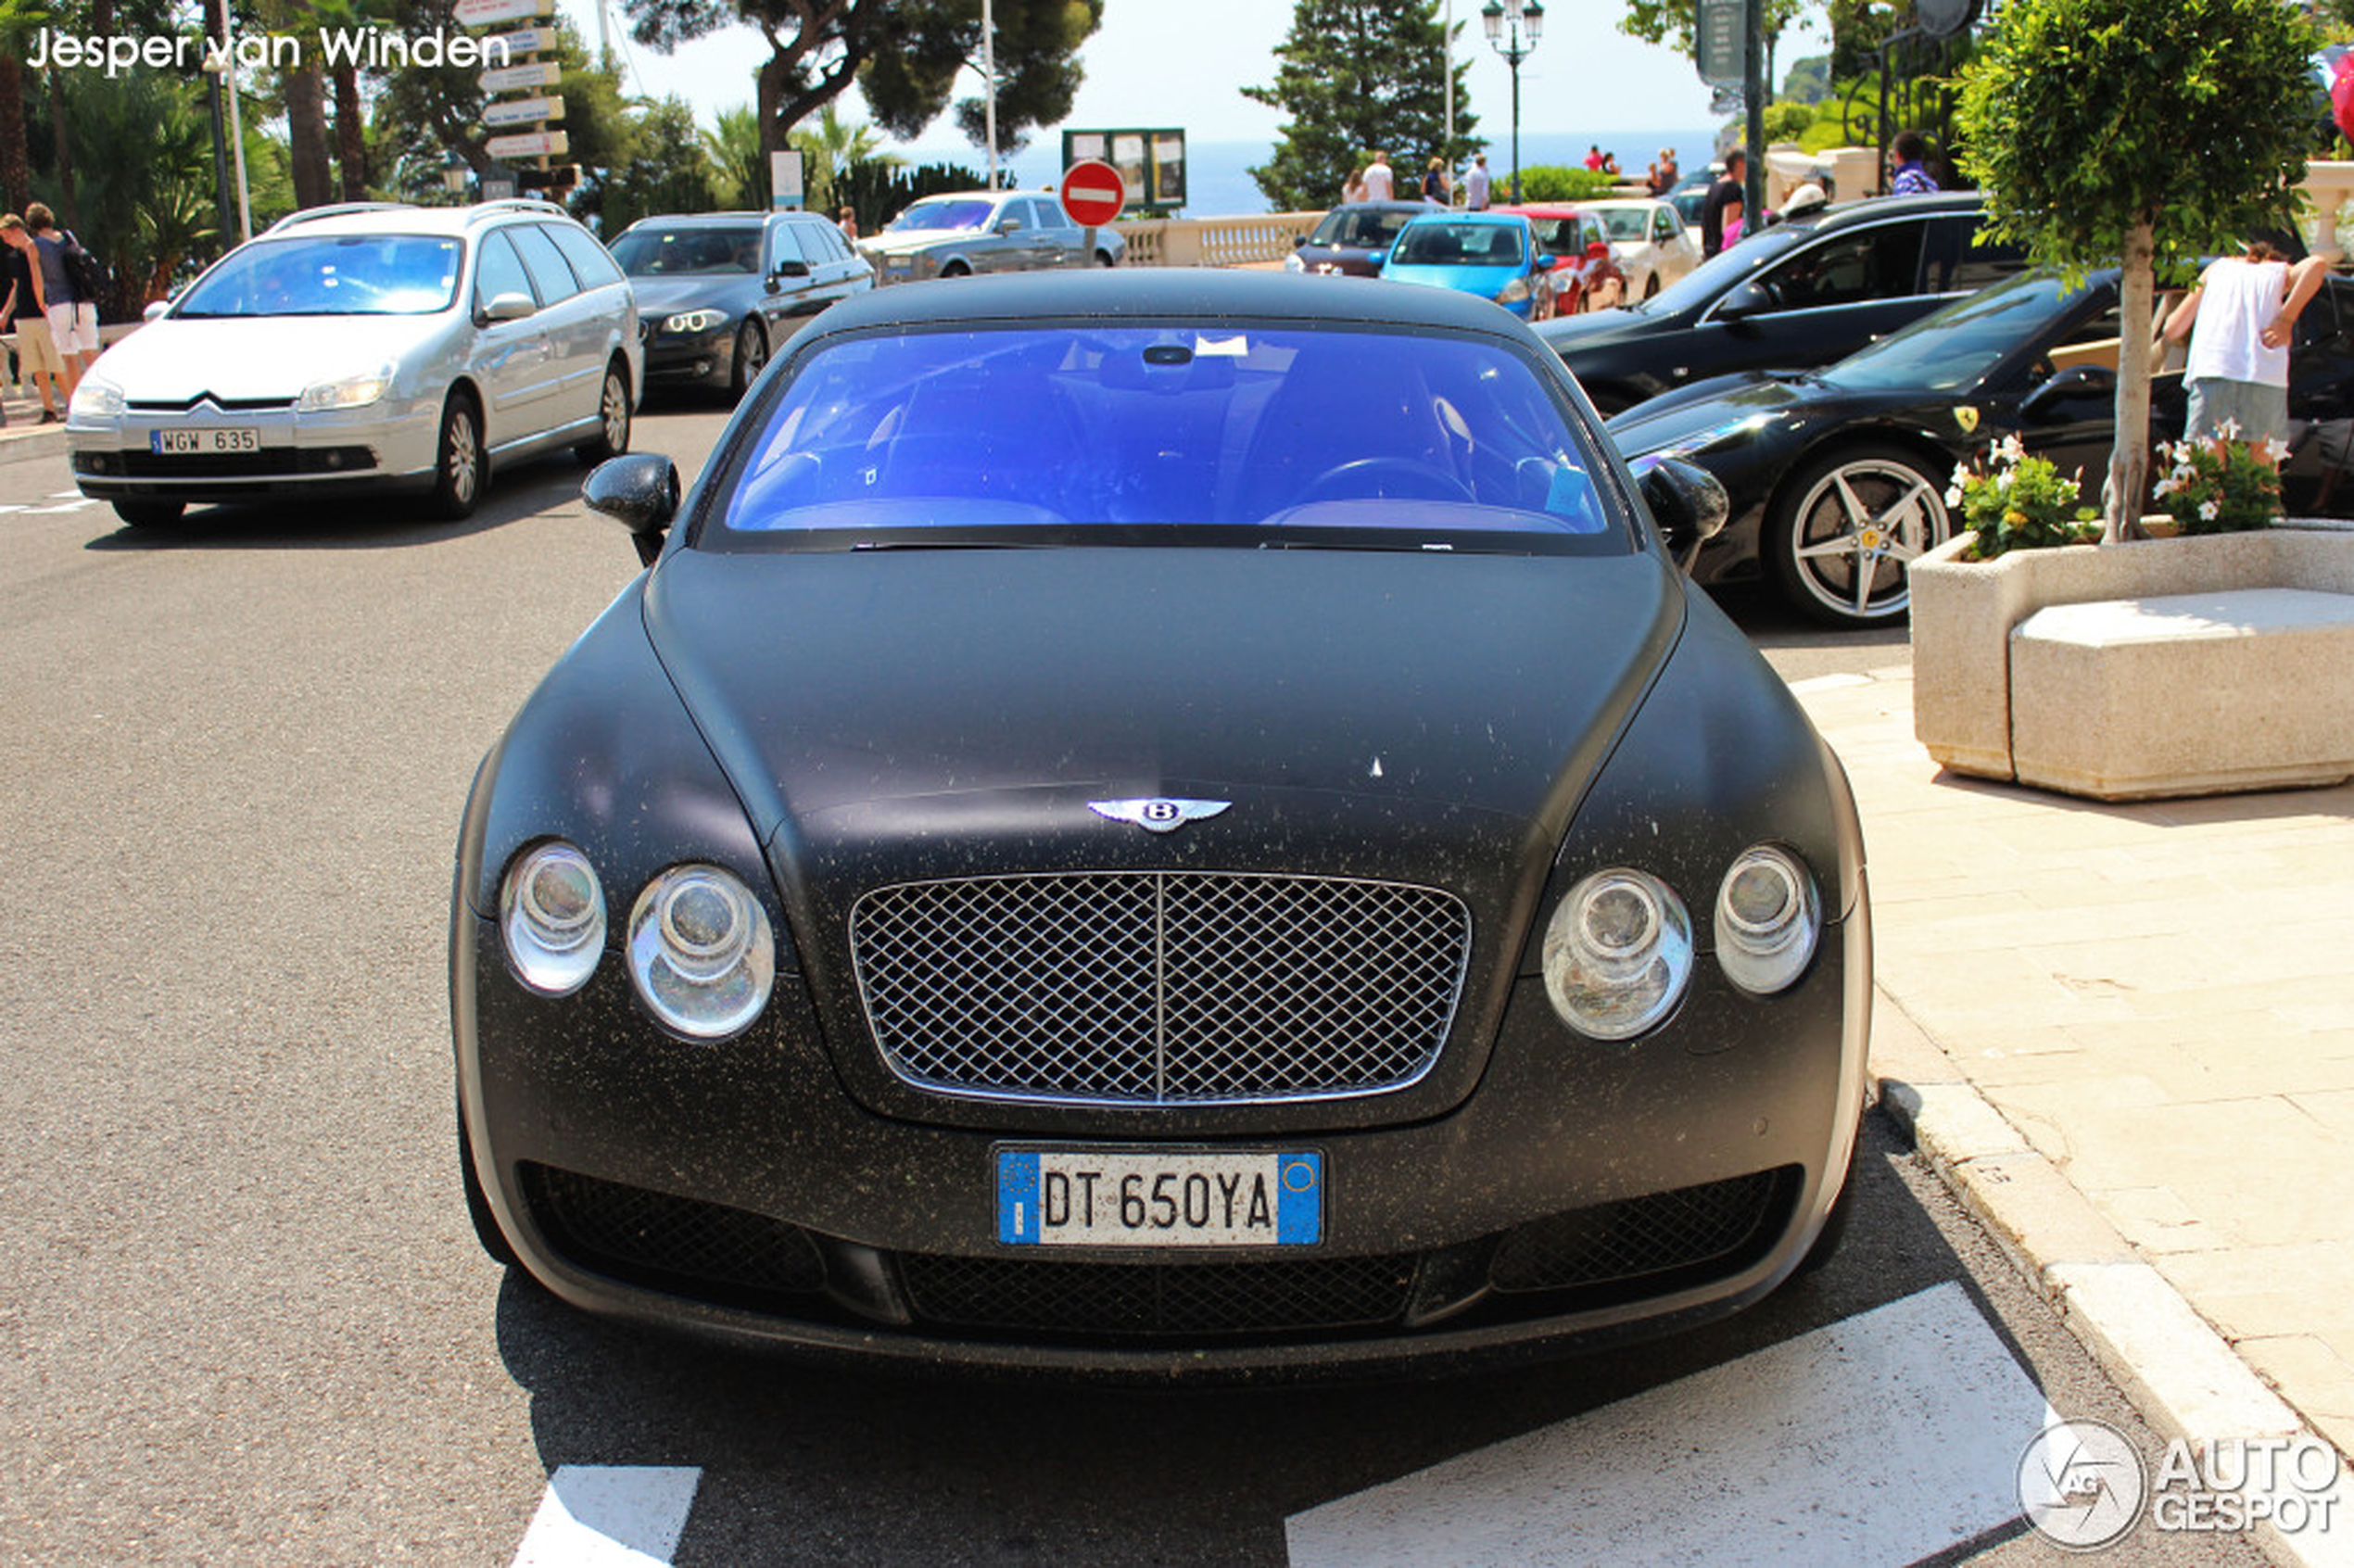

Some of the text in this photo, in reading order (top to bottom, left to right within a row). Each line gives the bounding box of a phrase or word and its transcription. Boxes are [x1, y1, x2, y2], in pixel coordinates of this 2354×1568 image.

[162, 431, 255, 451] WGW 635
[1044, 1171, 1272, 1230] DT 650YA
